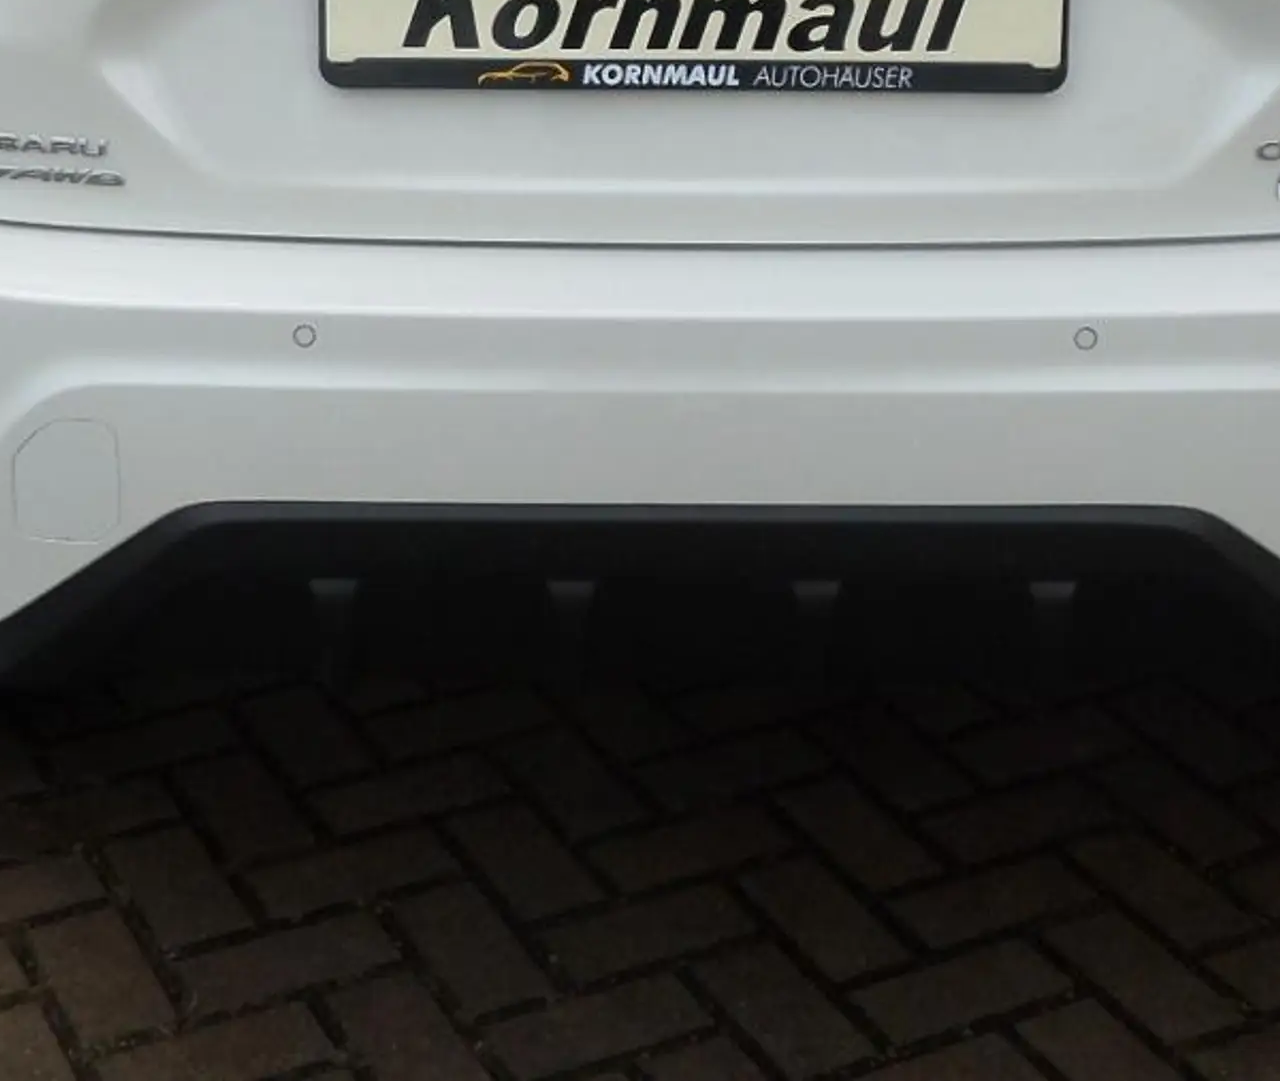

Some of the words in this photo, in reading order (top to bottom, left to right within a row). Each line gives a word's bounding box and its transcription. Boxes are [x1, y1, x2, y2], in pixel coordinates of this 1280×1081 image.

[582, 62, 740, 87] KORNMAUL
[753, 64, 914, 89] AUTOHÄUSER
[8, 167, 126, 187] AWD
